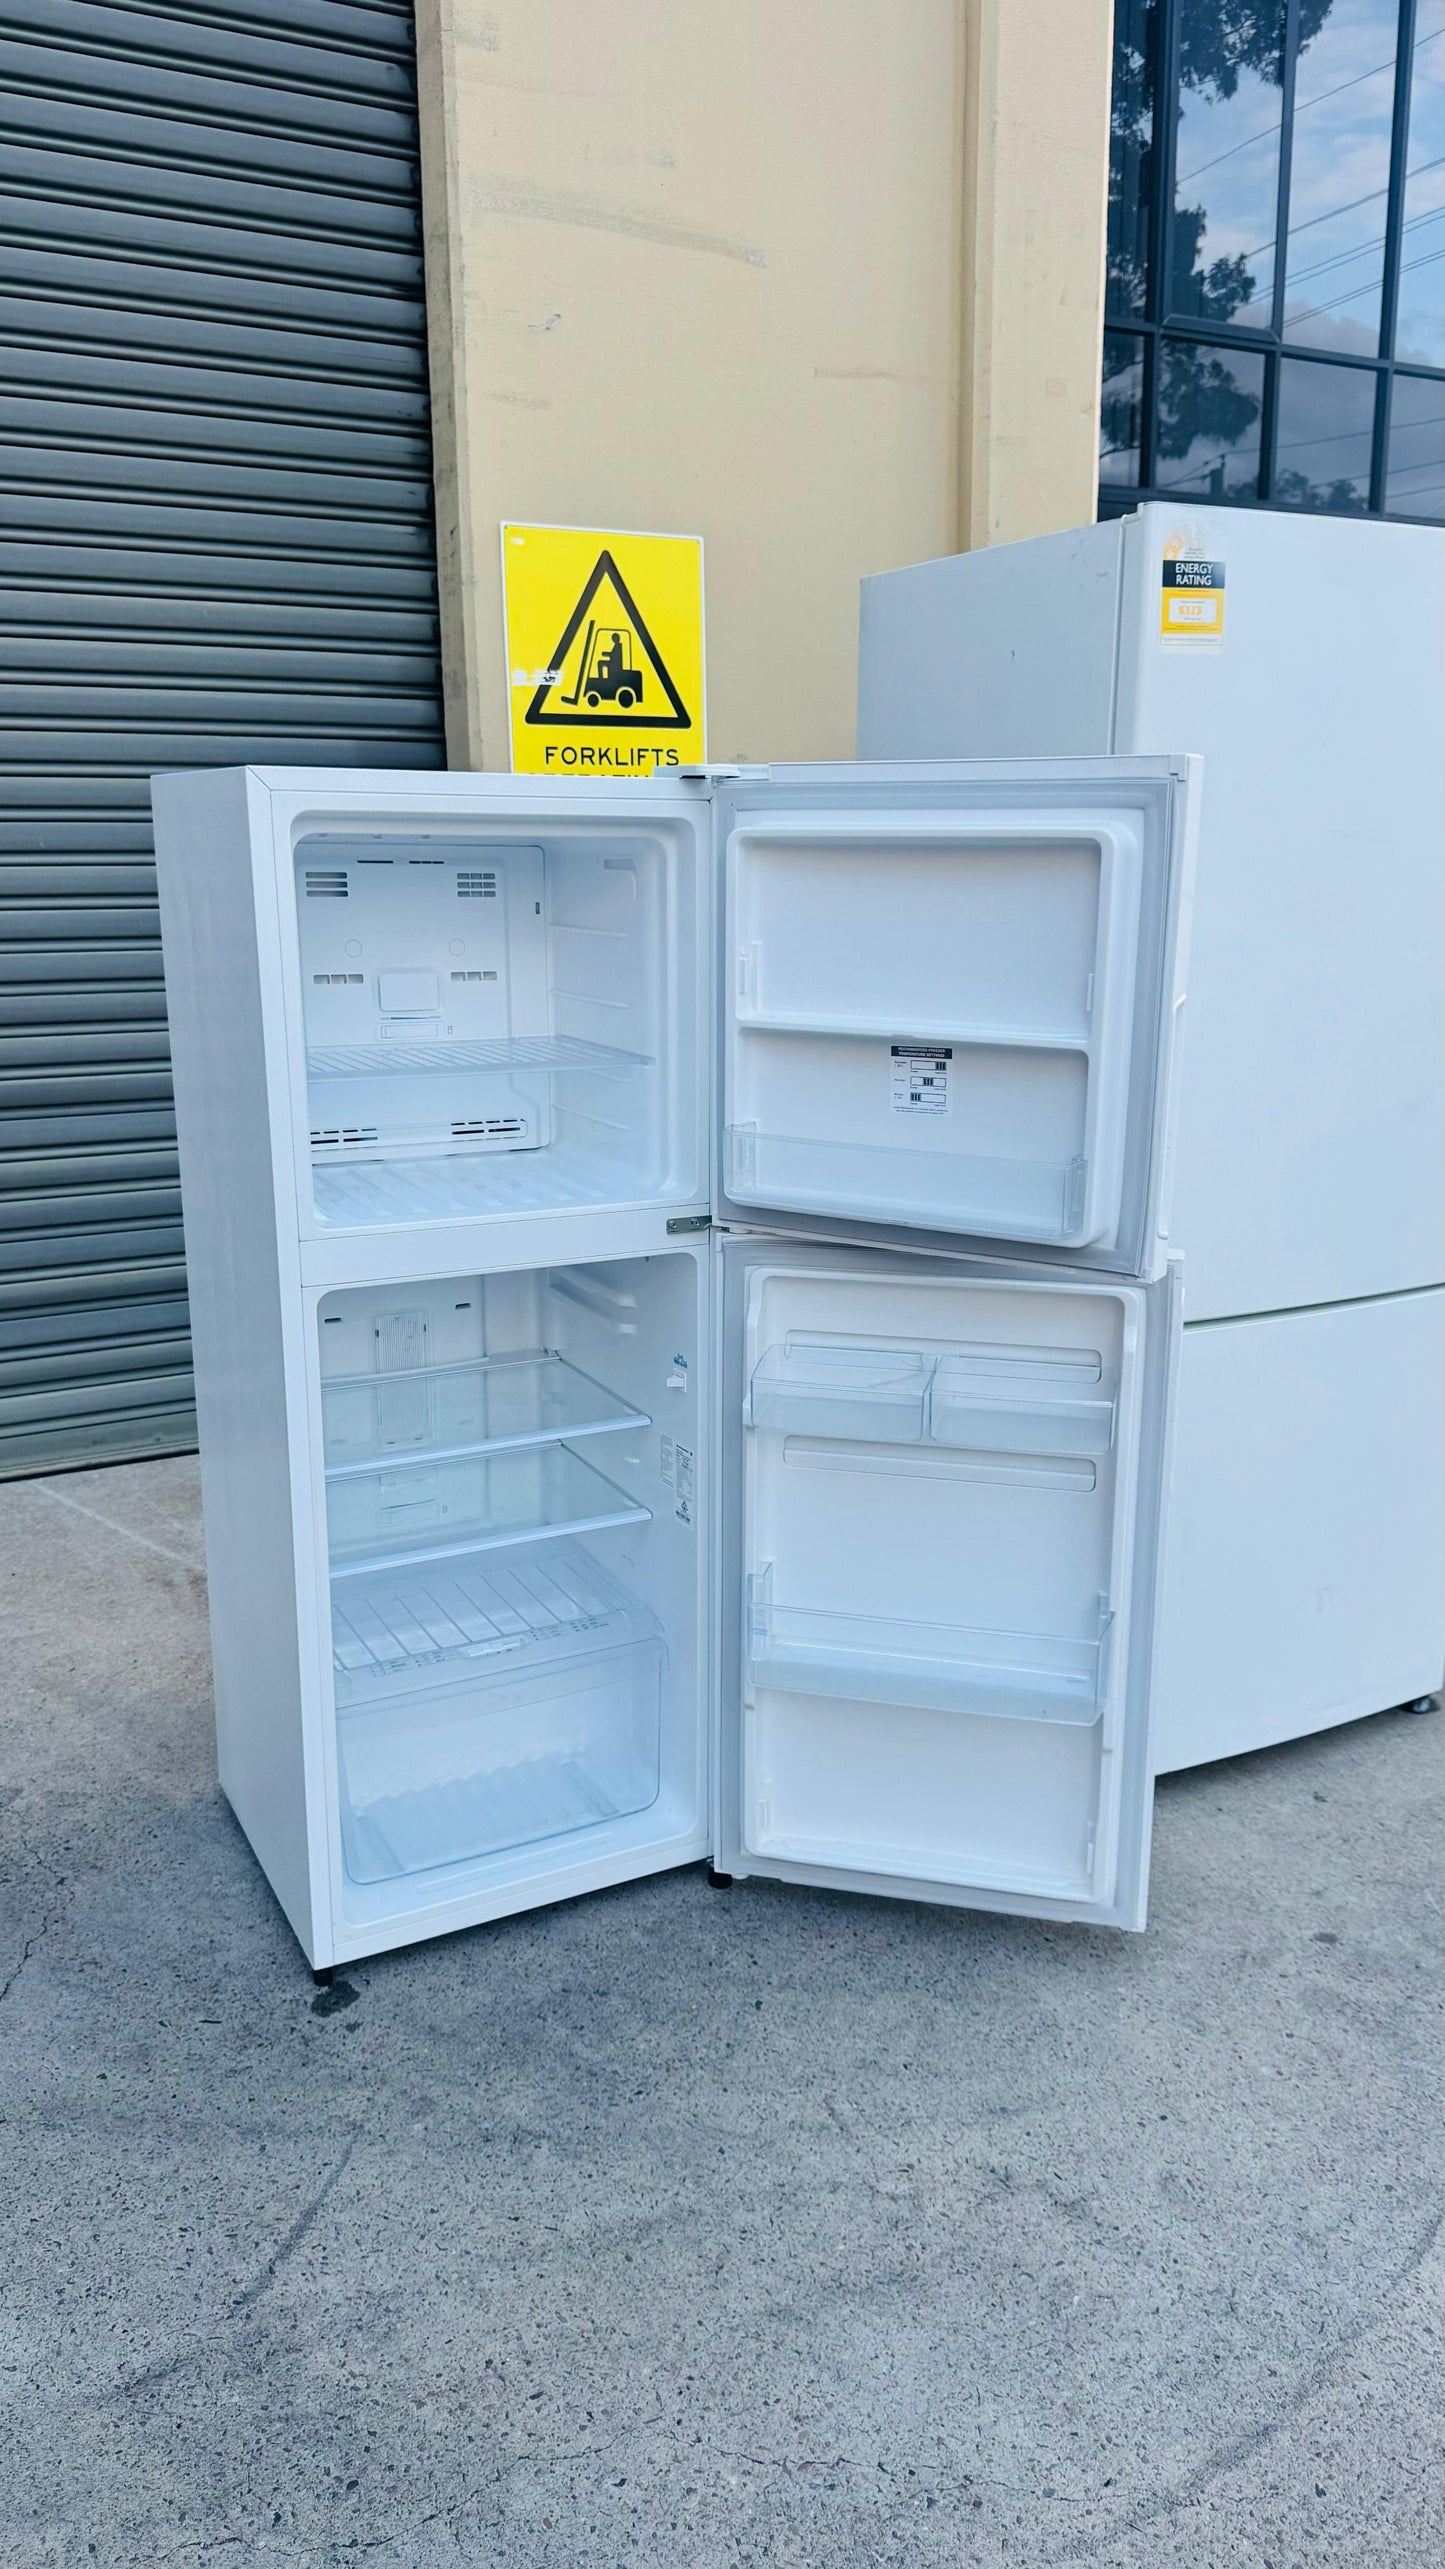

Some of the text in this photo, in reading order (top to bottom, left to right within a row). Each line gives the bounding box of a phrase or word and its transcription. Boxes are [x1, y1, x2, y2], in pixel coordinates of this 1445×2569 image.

[1175, 562, 1214, 574] ENERGY
[1176, 574, 1212, 586] RATING
[545, 746, 680, 767] FORKLIFTS
